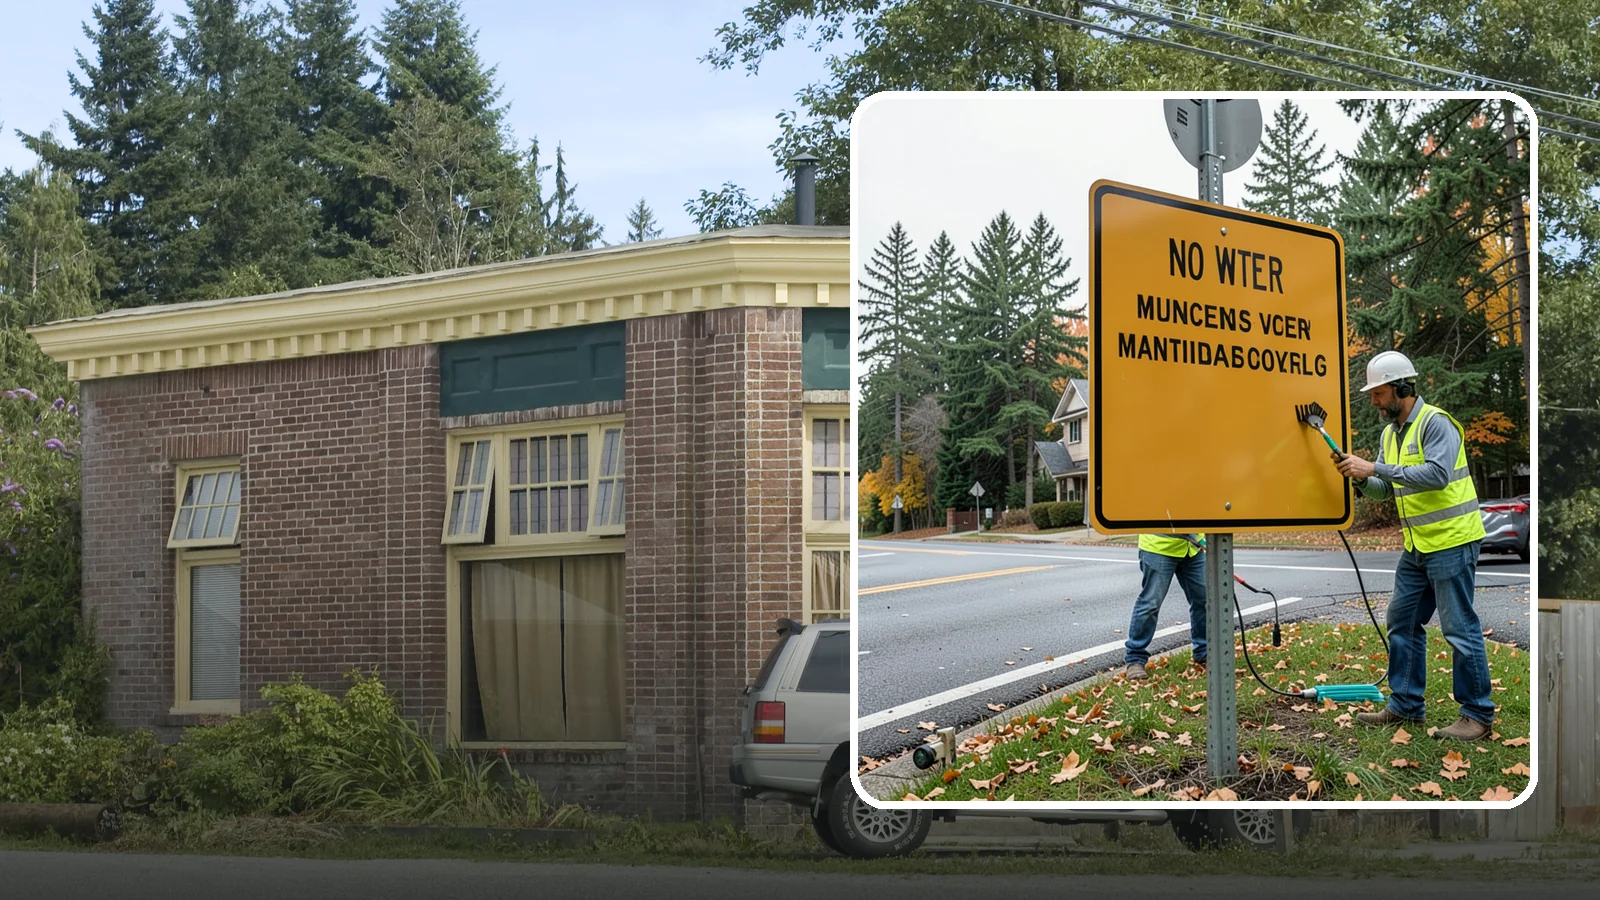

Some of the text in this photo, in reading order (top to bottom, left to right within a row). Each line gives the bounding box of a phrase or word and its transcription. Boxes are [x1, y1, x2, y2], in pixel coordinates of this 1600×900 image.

[1169, 237, 1284, 295] NO WTER
[1137, 293, 1252, 333] MUNCENS
